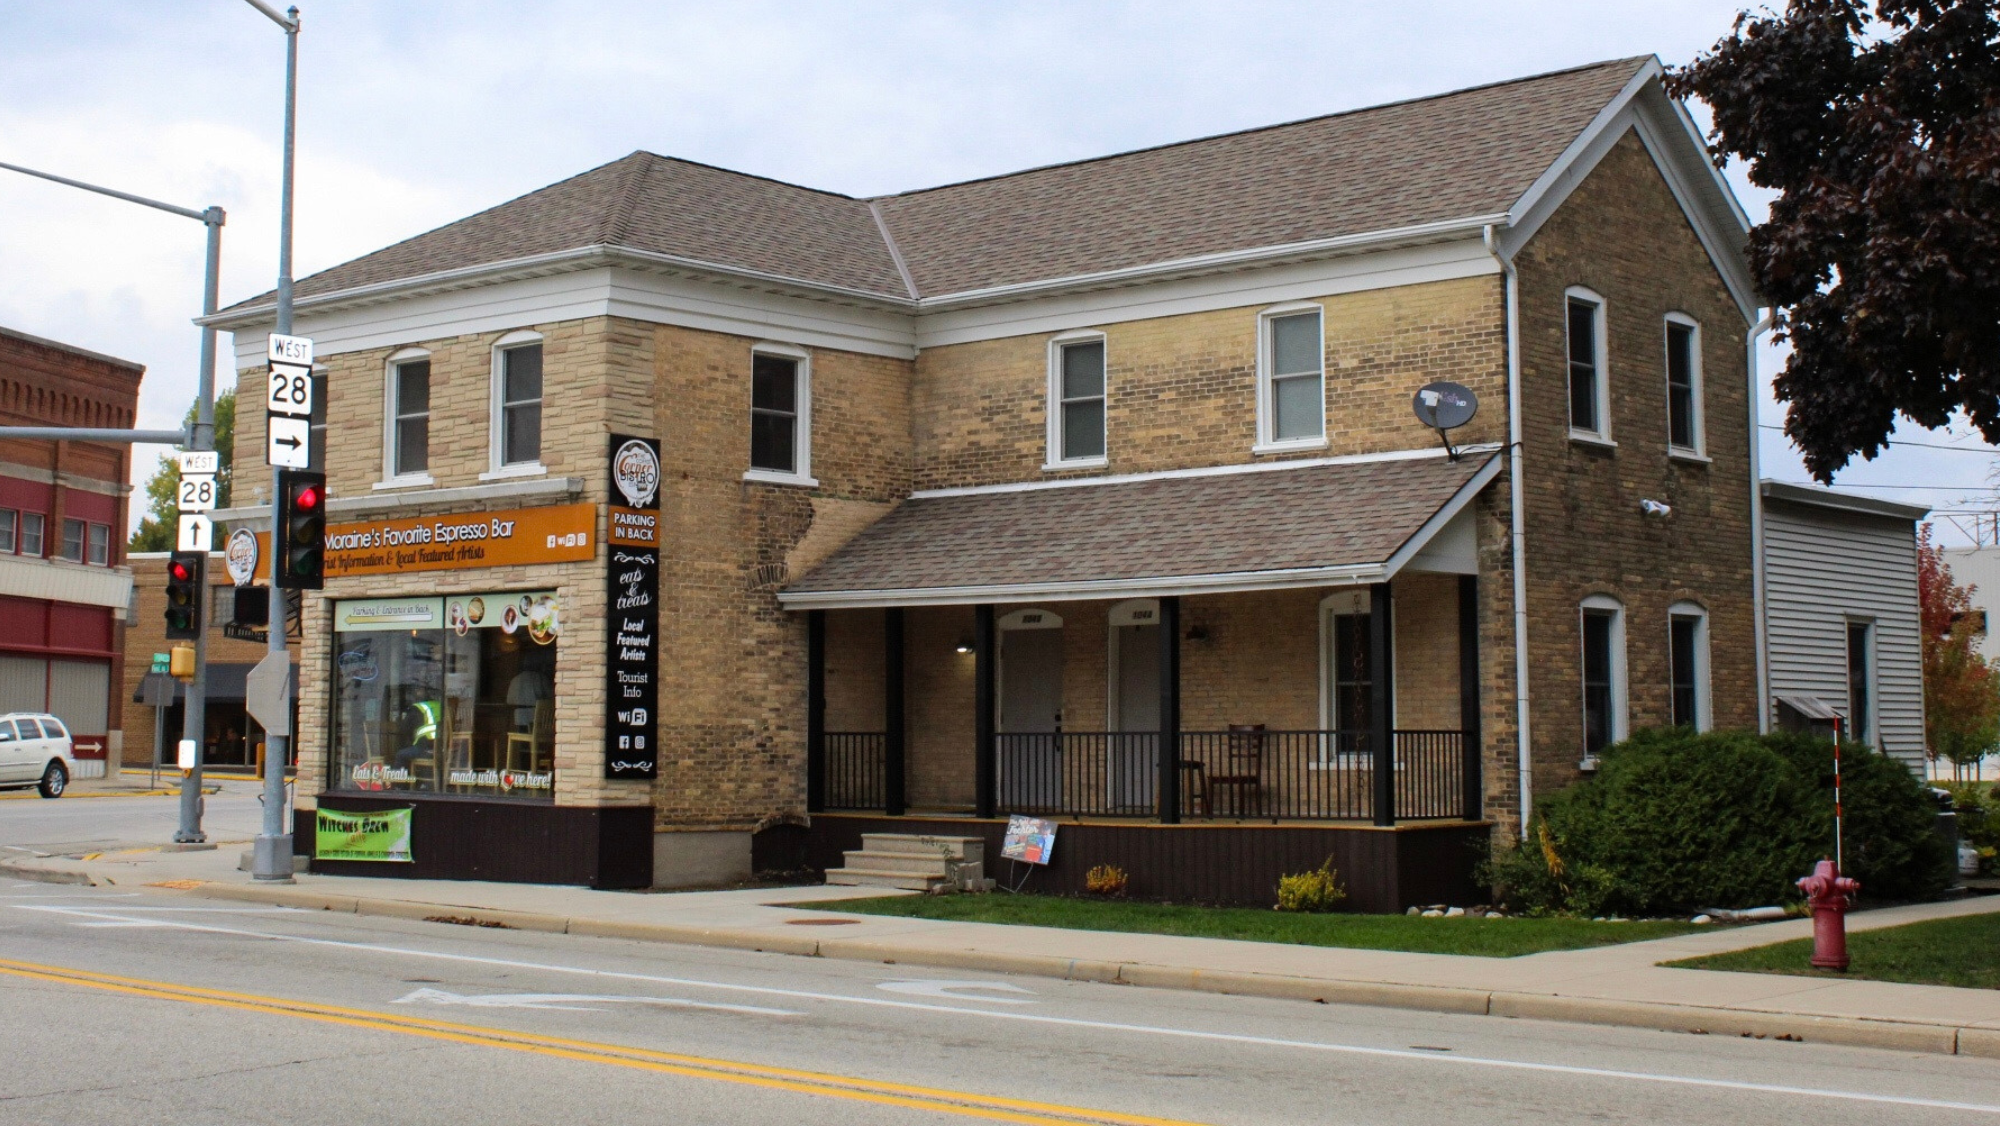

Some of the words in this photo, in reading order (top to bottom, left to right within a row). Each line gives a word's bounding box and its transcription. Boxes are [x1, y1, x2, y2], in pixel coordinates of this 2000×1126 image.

[275, 338, 307, 359] WEST
[272, 373, 306, 404] 28
[185, 456, 213, 468] WEST
[619, 453, 653, 474] Corner
[620, 470, 655, 484] BISTRO
[182, 482, 211, 503] 28
[614, 512, 655, 527] PARKING
[383, 524, 431, 546] Favorite
[434, 522, 488, 547] Espresso
[491, 518, 515, 538] Bar
[615, 527, 625, 538] IN
[628, 528, 654, 540] BACK
[338, 553, 384, 572] Information
[386, 551, 394, 565] &
[396, 550, 416, 568] Local
[418, 547, 455, 563] Featured
[457, 545, 485, 562] Artists
[620, 566, 645, 584] eats
[626, 582, 638, 597] &
[616, 590, 652, 610] treats
[353, 605, 375, 616] Parking
[415, 604, 430, 613] Back
[623, 617, 644, 631] Local
[616, 632, 650, 647] Featured
[620, 647, 646, 661] Artists
[617, 671, 648, 683] Tourist
[623, 685, 642, 697] Info
[352, 764, 370, 780] Eats
[372, 765, 380, 780] &
[450, 769, 477, 783] made
[478, 769, 498, 785] with
[526, 770, 553, 789] here!
